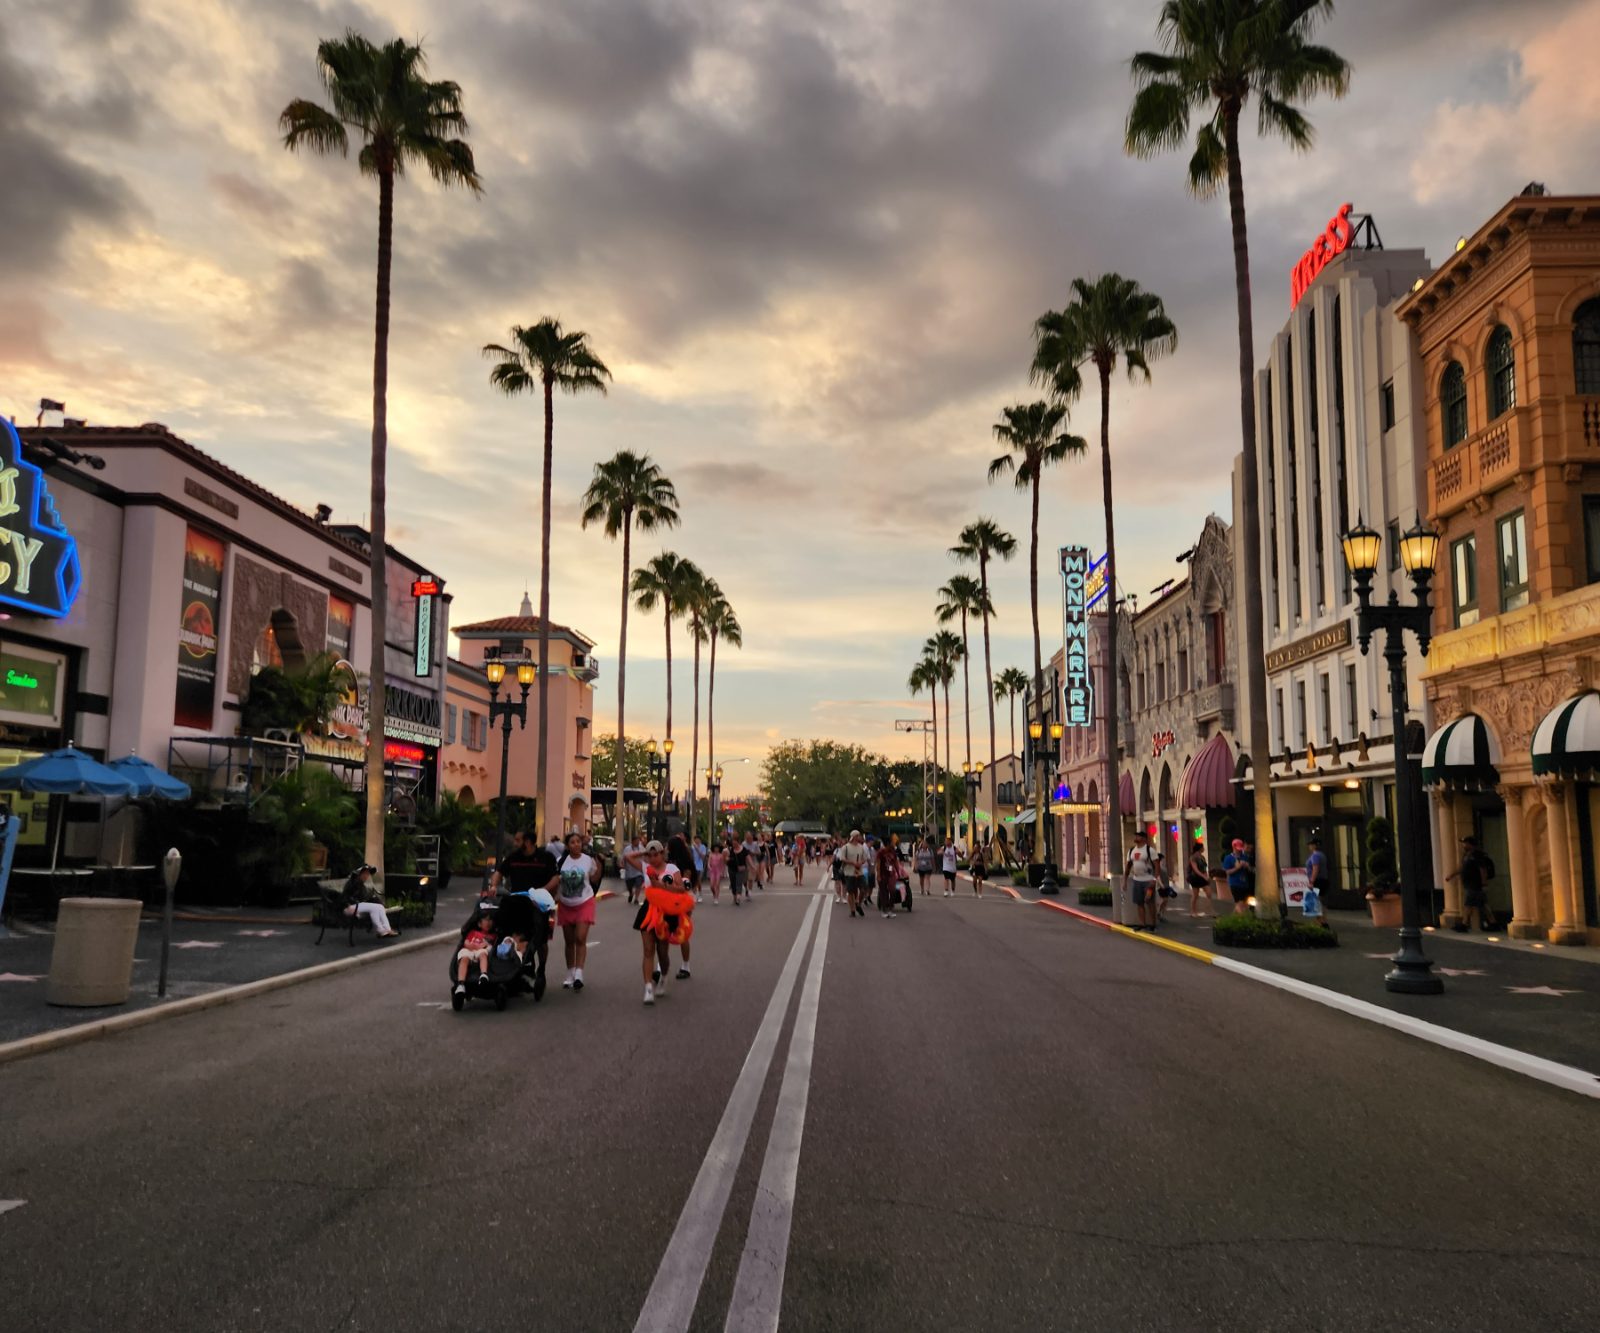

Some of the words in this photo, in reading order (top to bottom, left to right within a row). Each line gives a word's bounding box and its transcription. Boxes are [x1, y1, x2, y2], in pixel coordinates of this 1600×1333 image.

[1065, 556, 1087, 722] MONTMARTRE
[1267, 647, 1296, 669] FIVE
[1298, 644, 1310, 657] &
[1312, 626, 1347, 651] DIME
[384, 686, 440, 728] ARKROOM
